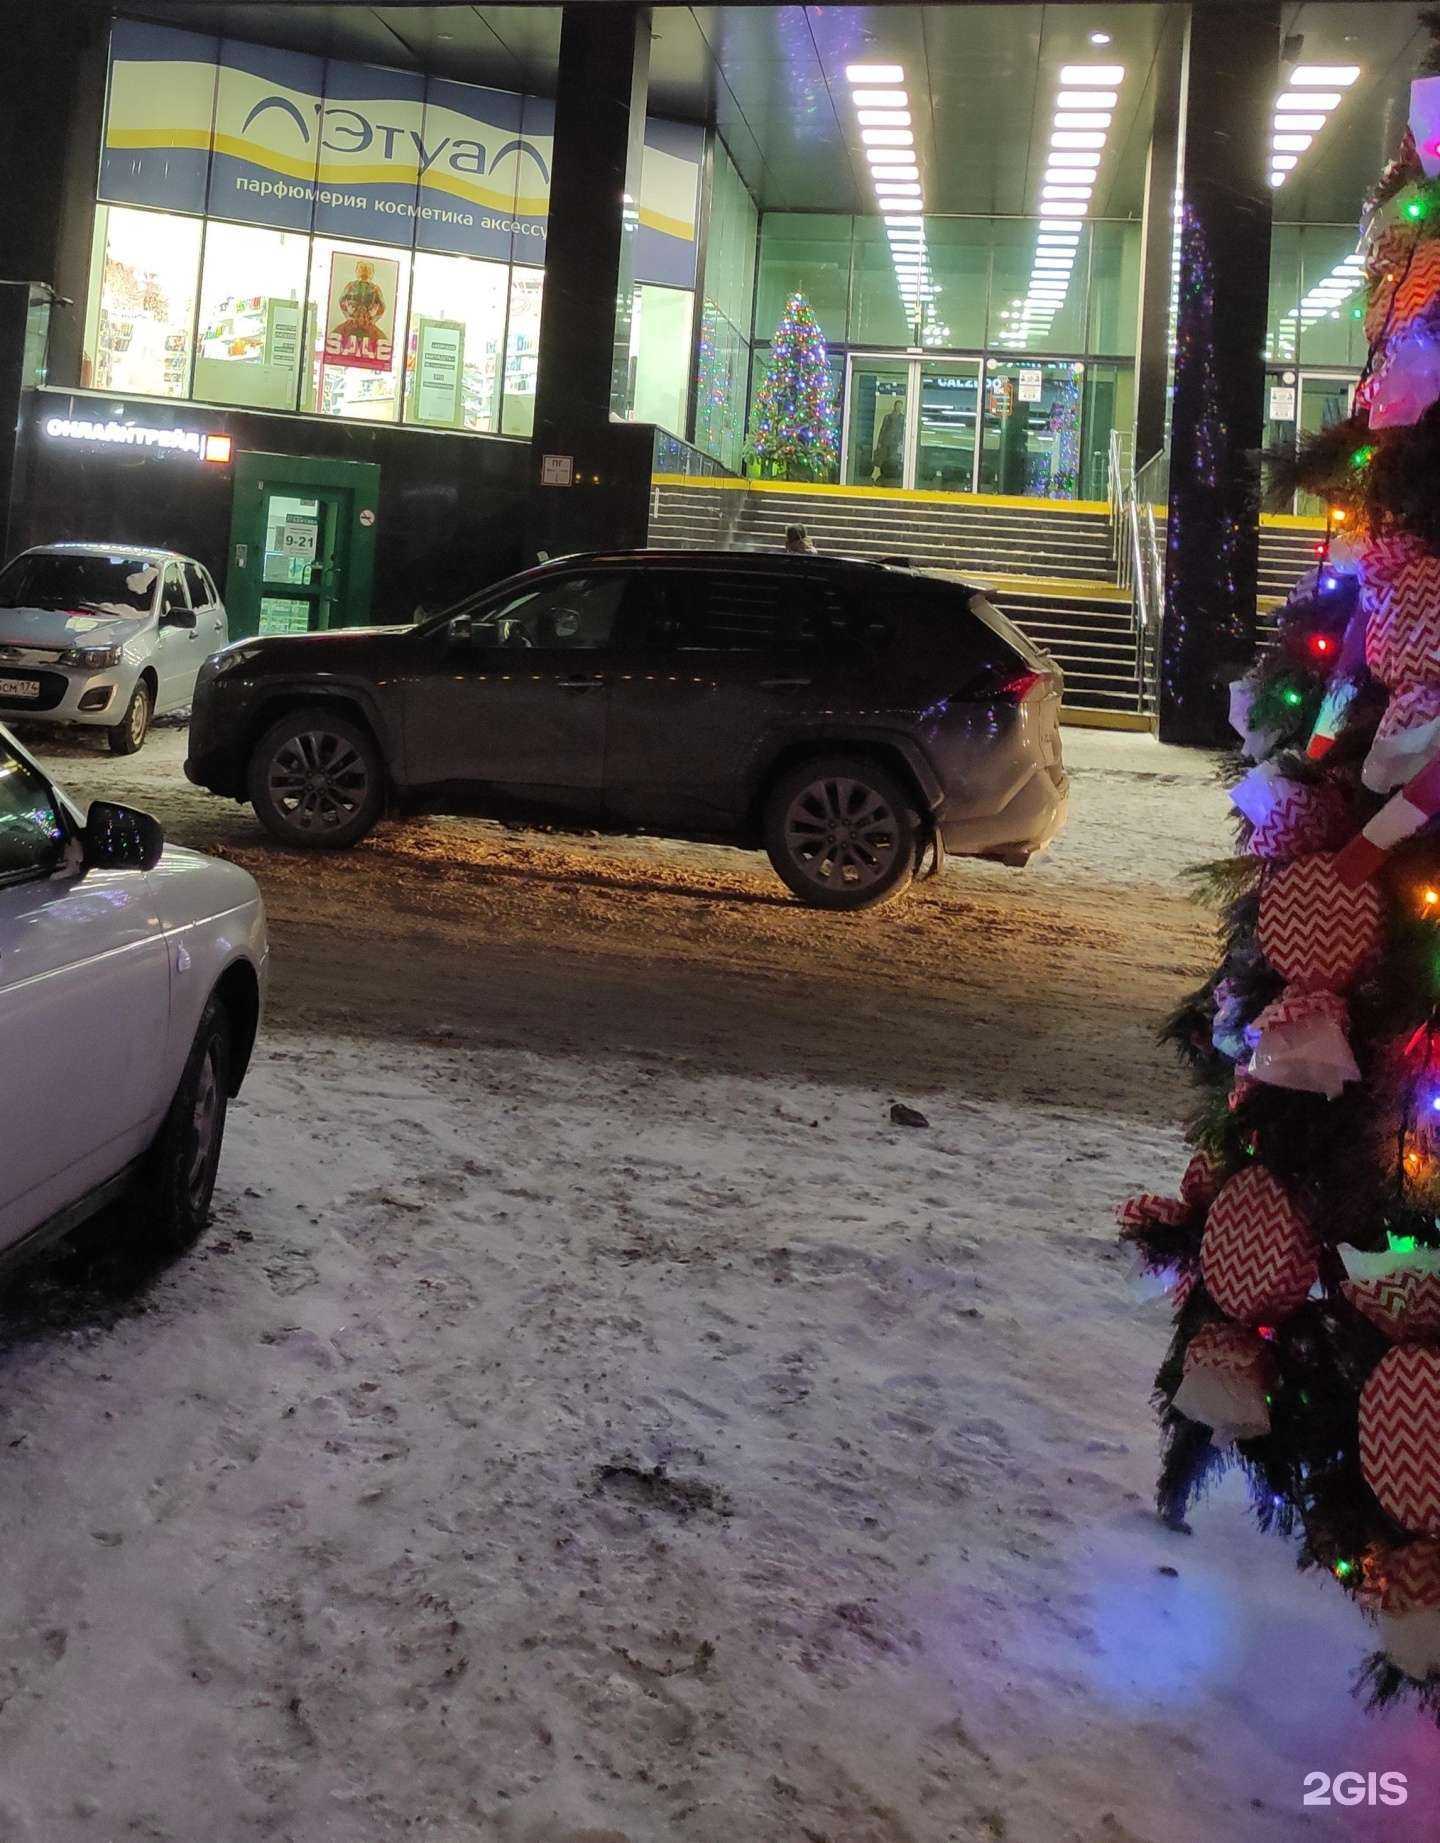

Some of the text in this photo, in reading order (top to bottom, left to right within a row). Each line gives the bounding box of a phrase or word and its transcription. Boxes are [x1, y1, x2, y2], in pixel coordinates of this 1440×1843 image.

[236, 176, 367, 210] парфюмерия
[374, 200, 473, 226] косметика
[325, 332, 392, 361] SALE
[286, 535, 314, 548] 9-21
